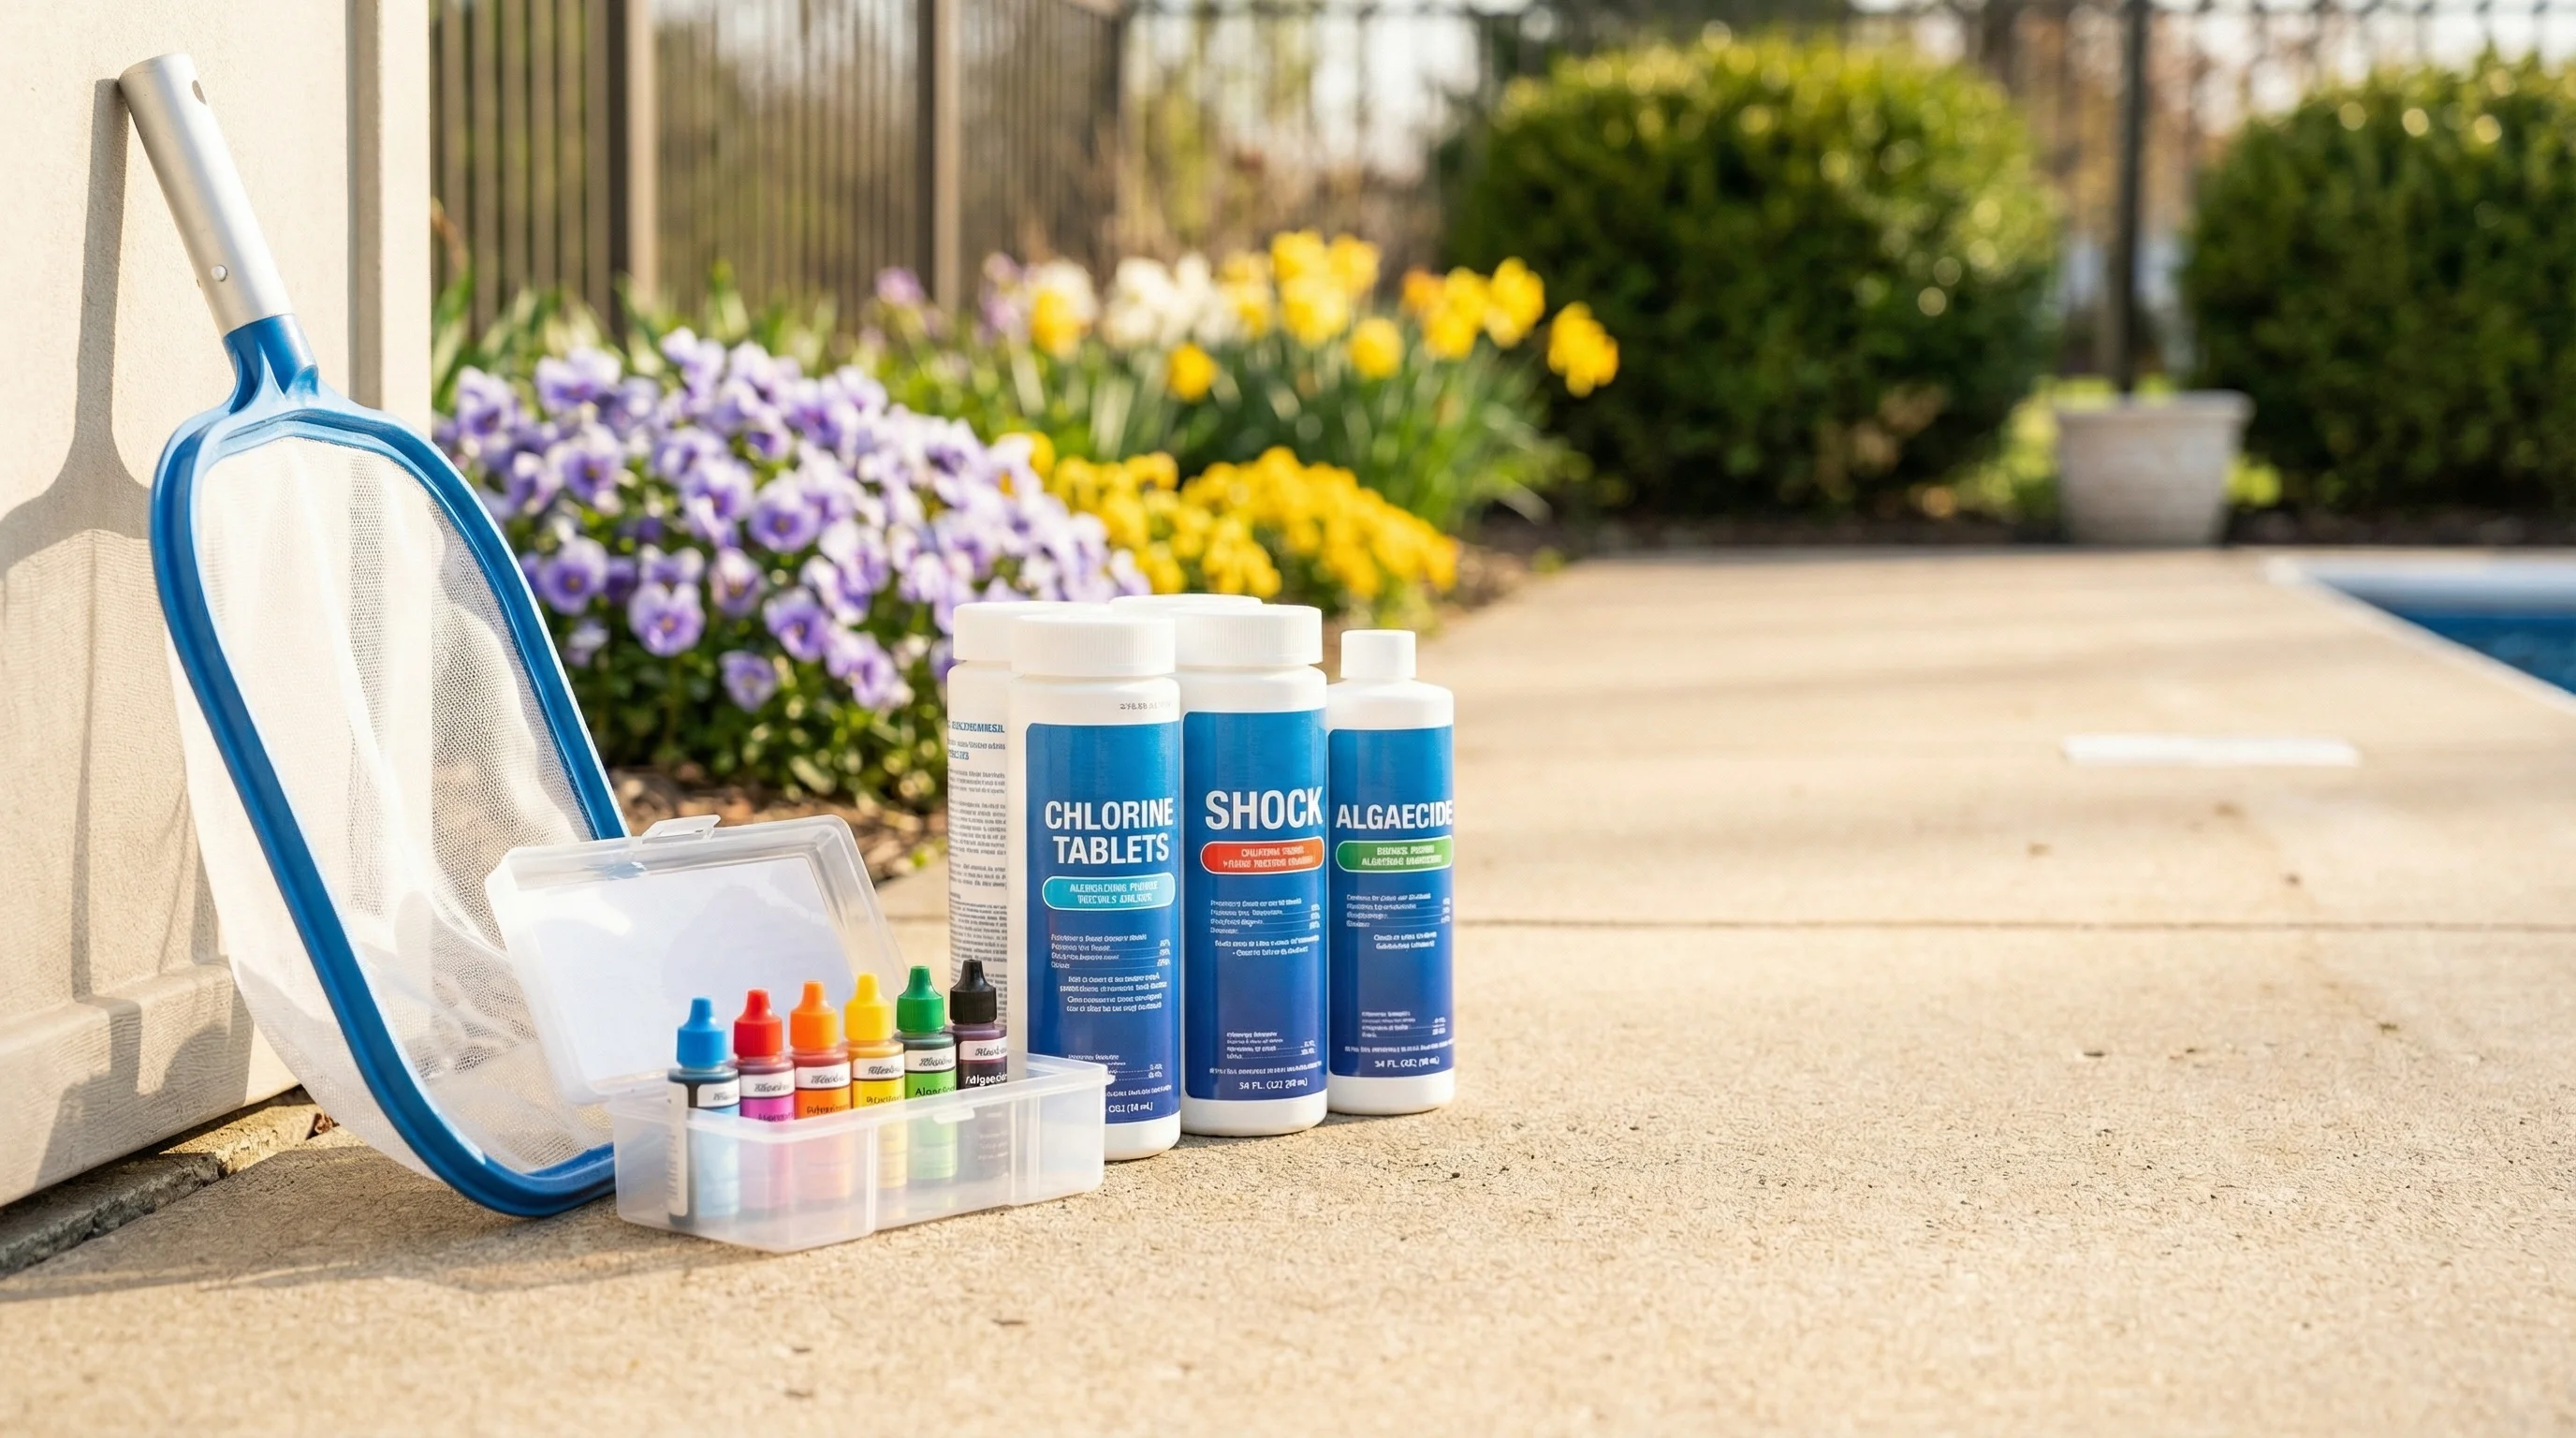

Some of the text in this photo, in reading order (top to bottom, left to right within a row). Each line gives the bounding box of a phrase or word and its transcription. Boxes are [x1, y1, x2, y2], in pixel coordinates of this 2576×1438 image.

[1045, 797, 1174, 830] CHLORINE
[1205, 785, 1324, 830] SHOCK
[1335, 799, 1453, 830] ALGAECIDE
[1052, 831, 1169, 865] TABLETS
